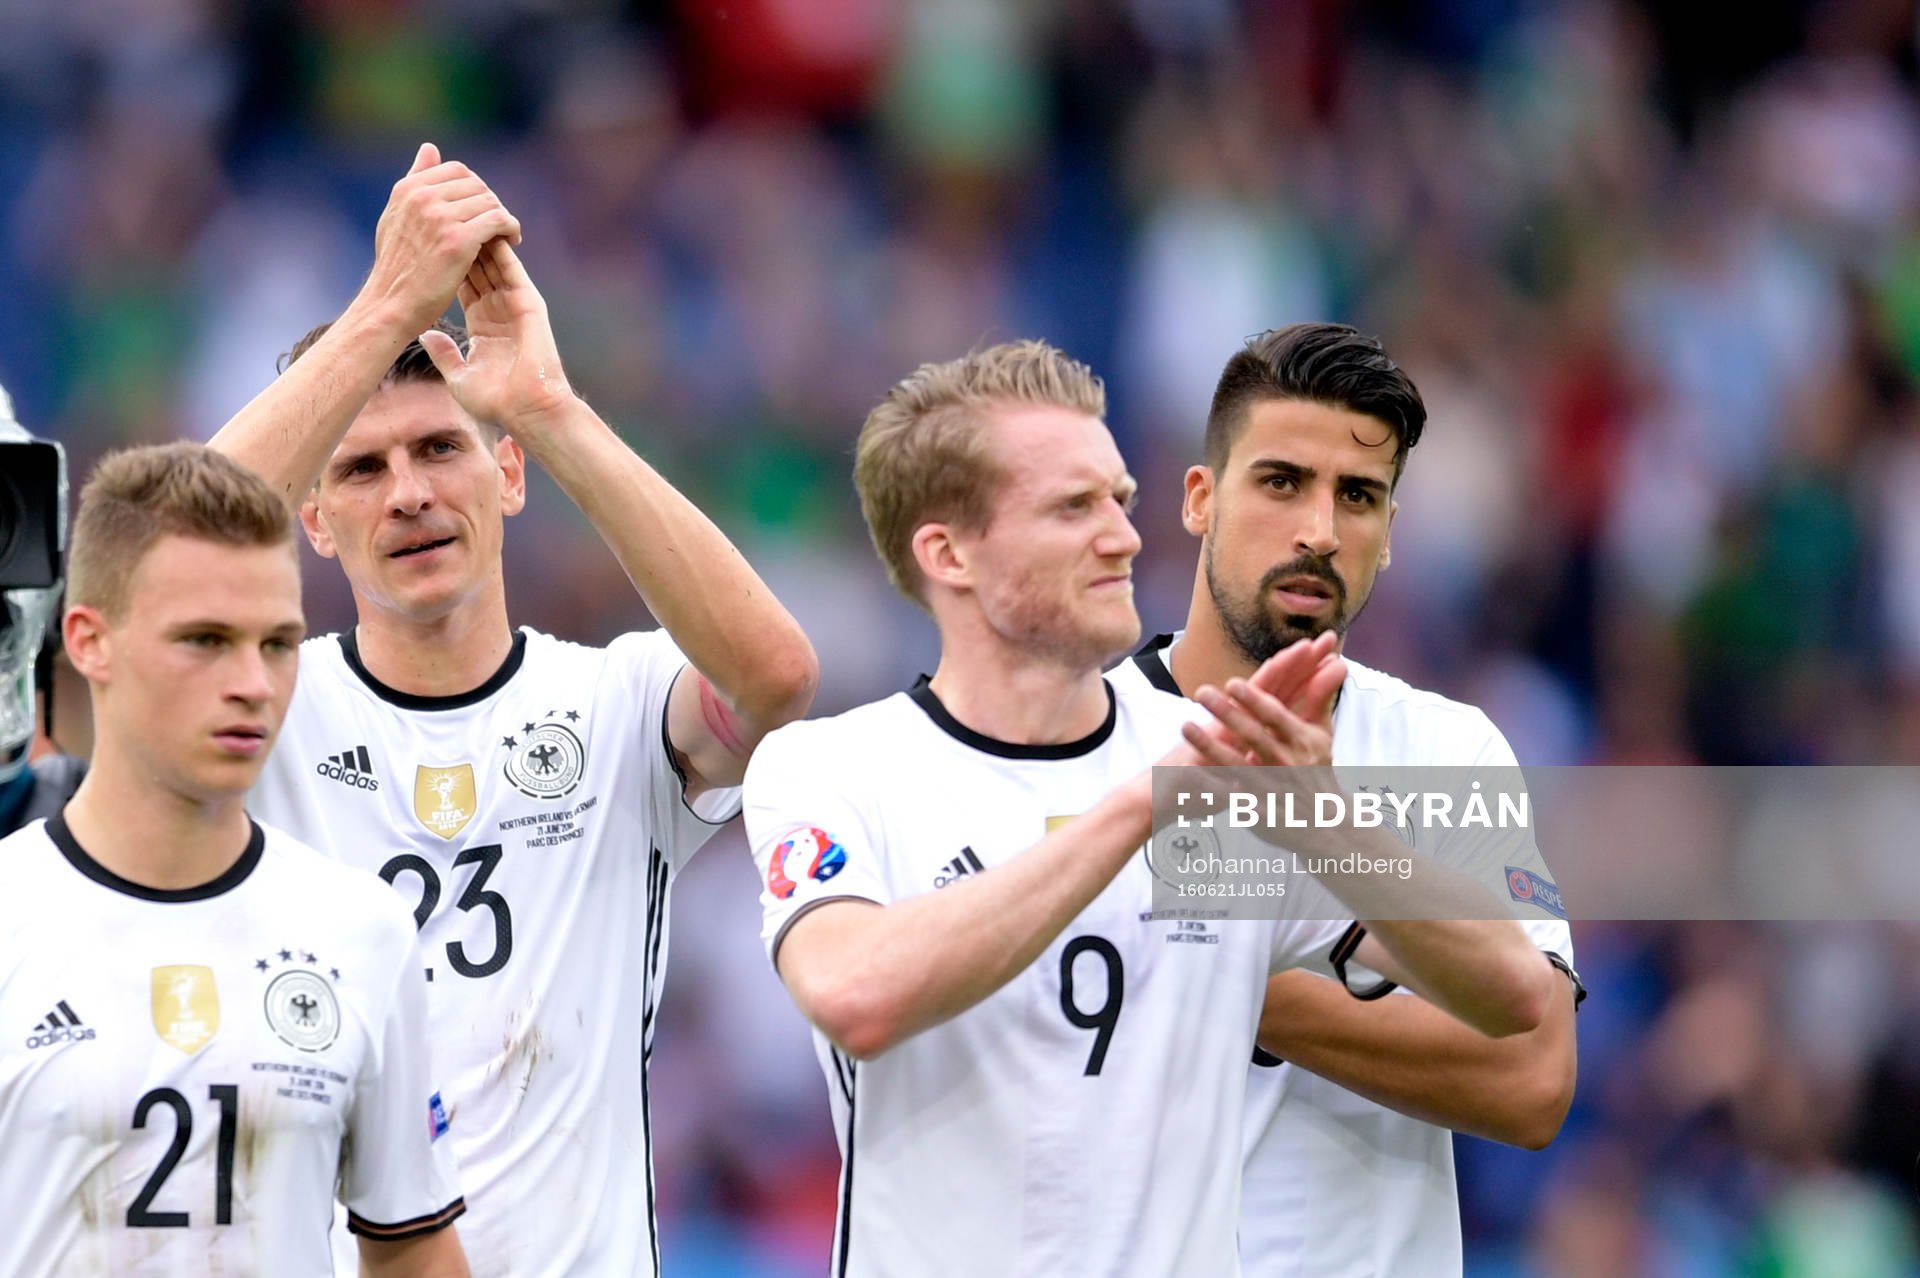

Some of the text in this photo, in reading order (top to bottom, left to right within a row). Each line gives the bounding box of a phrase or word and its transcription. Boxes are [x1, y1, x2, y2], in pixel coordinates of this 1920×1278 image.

[317, 762, 379, 791] adidas
[499, 815, 537, 831] NORTHERN
[526, 836, 545, 849] PARC
[546, 836, 559, 846] DES
[1532, 881, 1566, 911] RESPE
[378, 843, 513, 983] 23
[1060, 935, 1124, 1077] 9
[26, 1028, 96, 1049] adidas
[126, 1084, 239, 1228] 21
